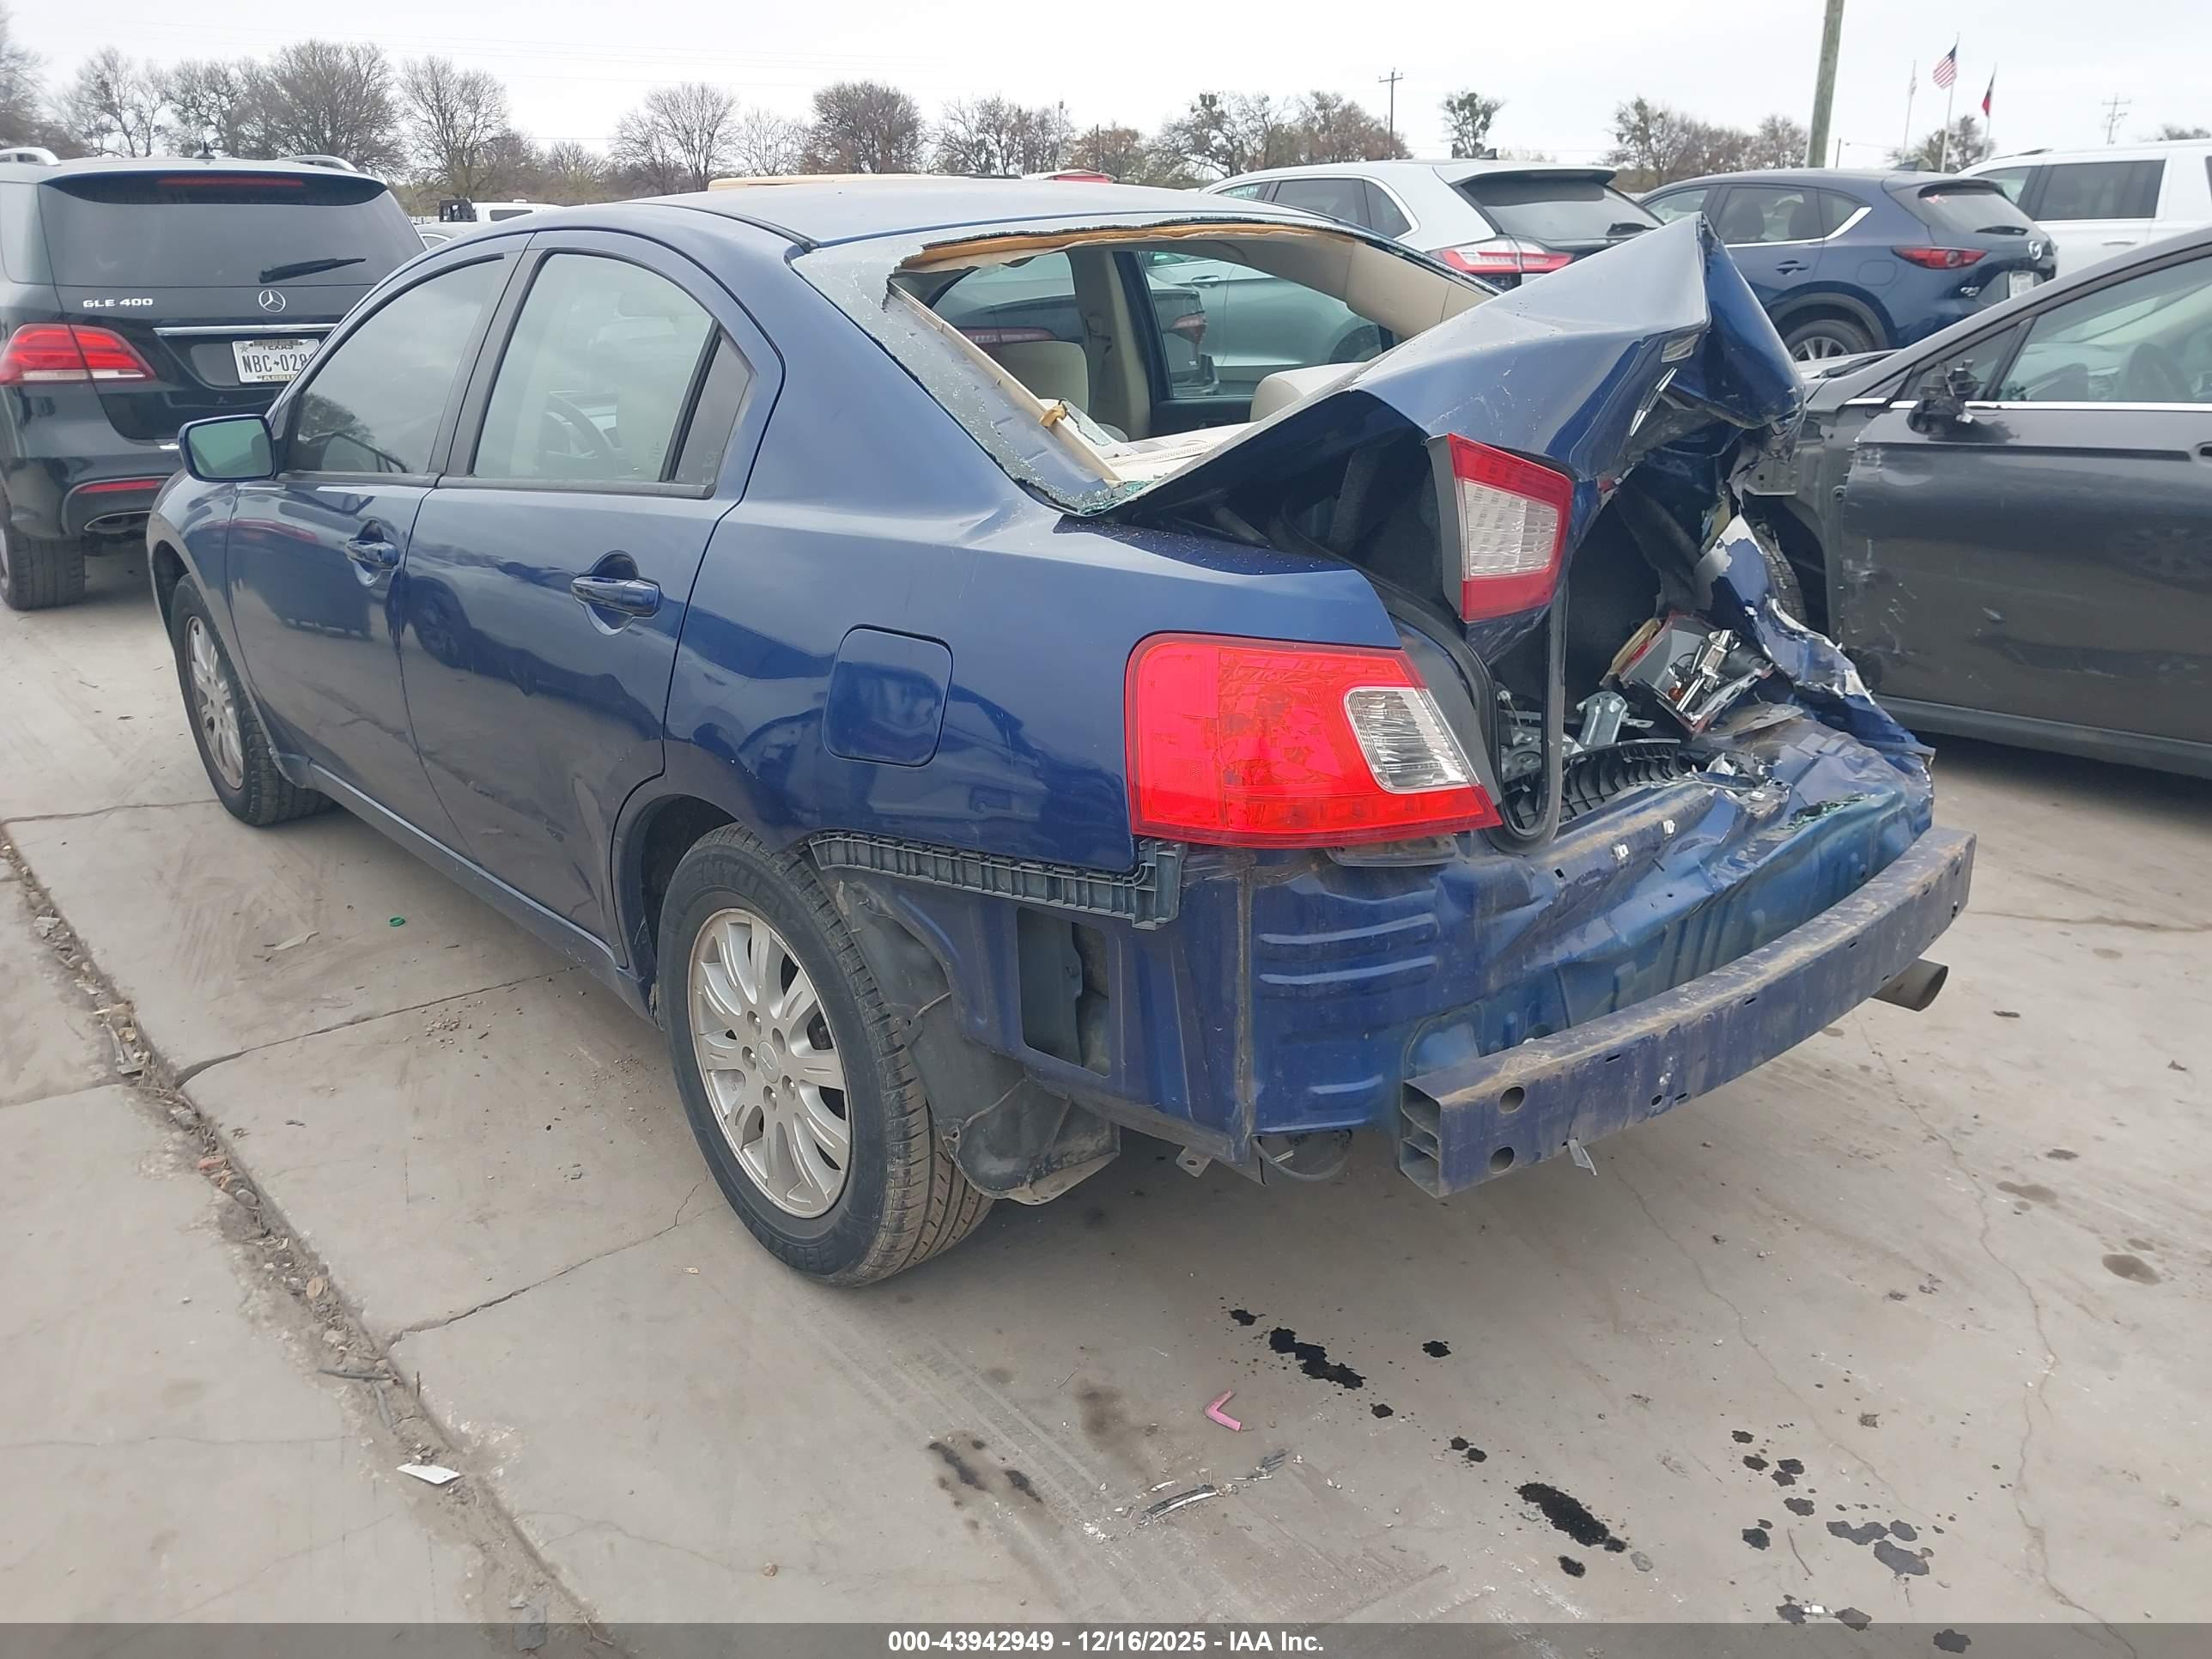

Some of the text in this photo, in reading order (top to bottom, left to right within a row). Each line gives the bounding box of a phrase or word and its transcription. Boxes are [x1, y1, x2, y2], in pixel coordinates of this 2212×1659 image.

[82, 298, 154, 307] GLE 400
[242, 353, 313, 374] NBC 028
